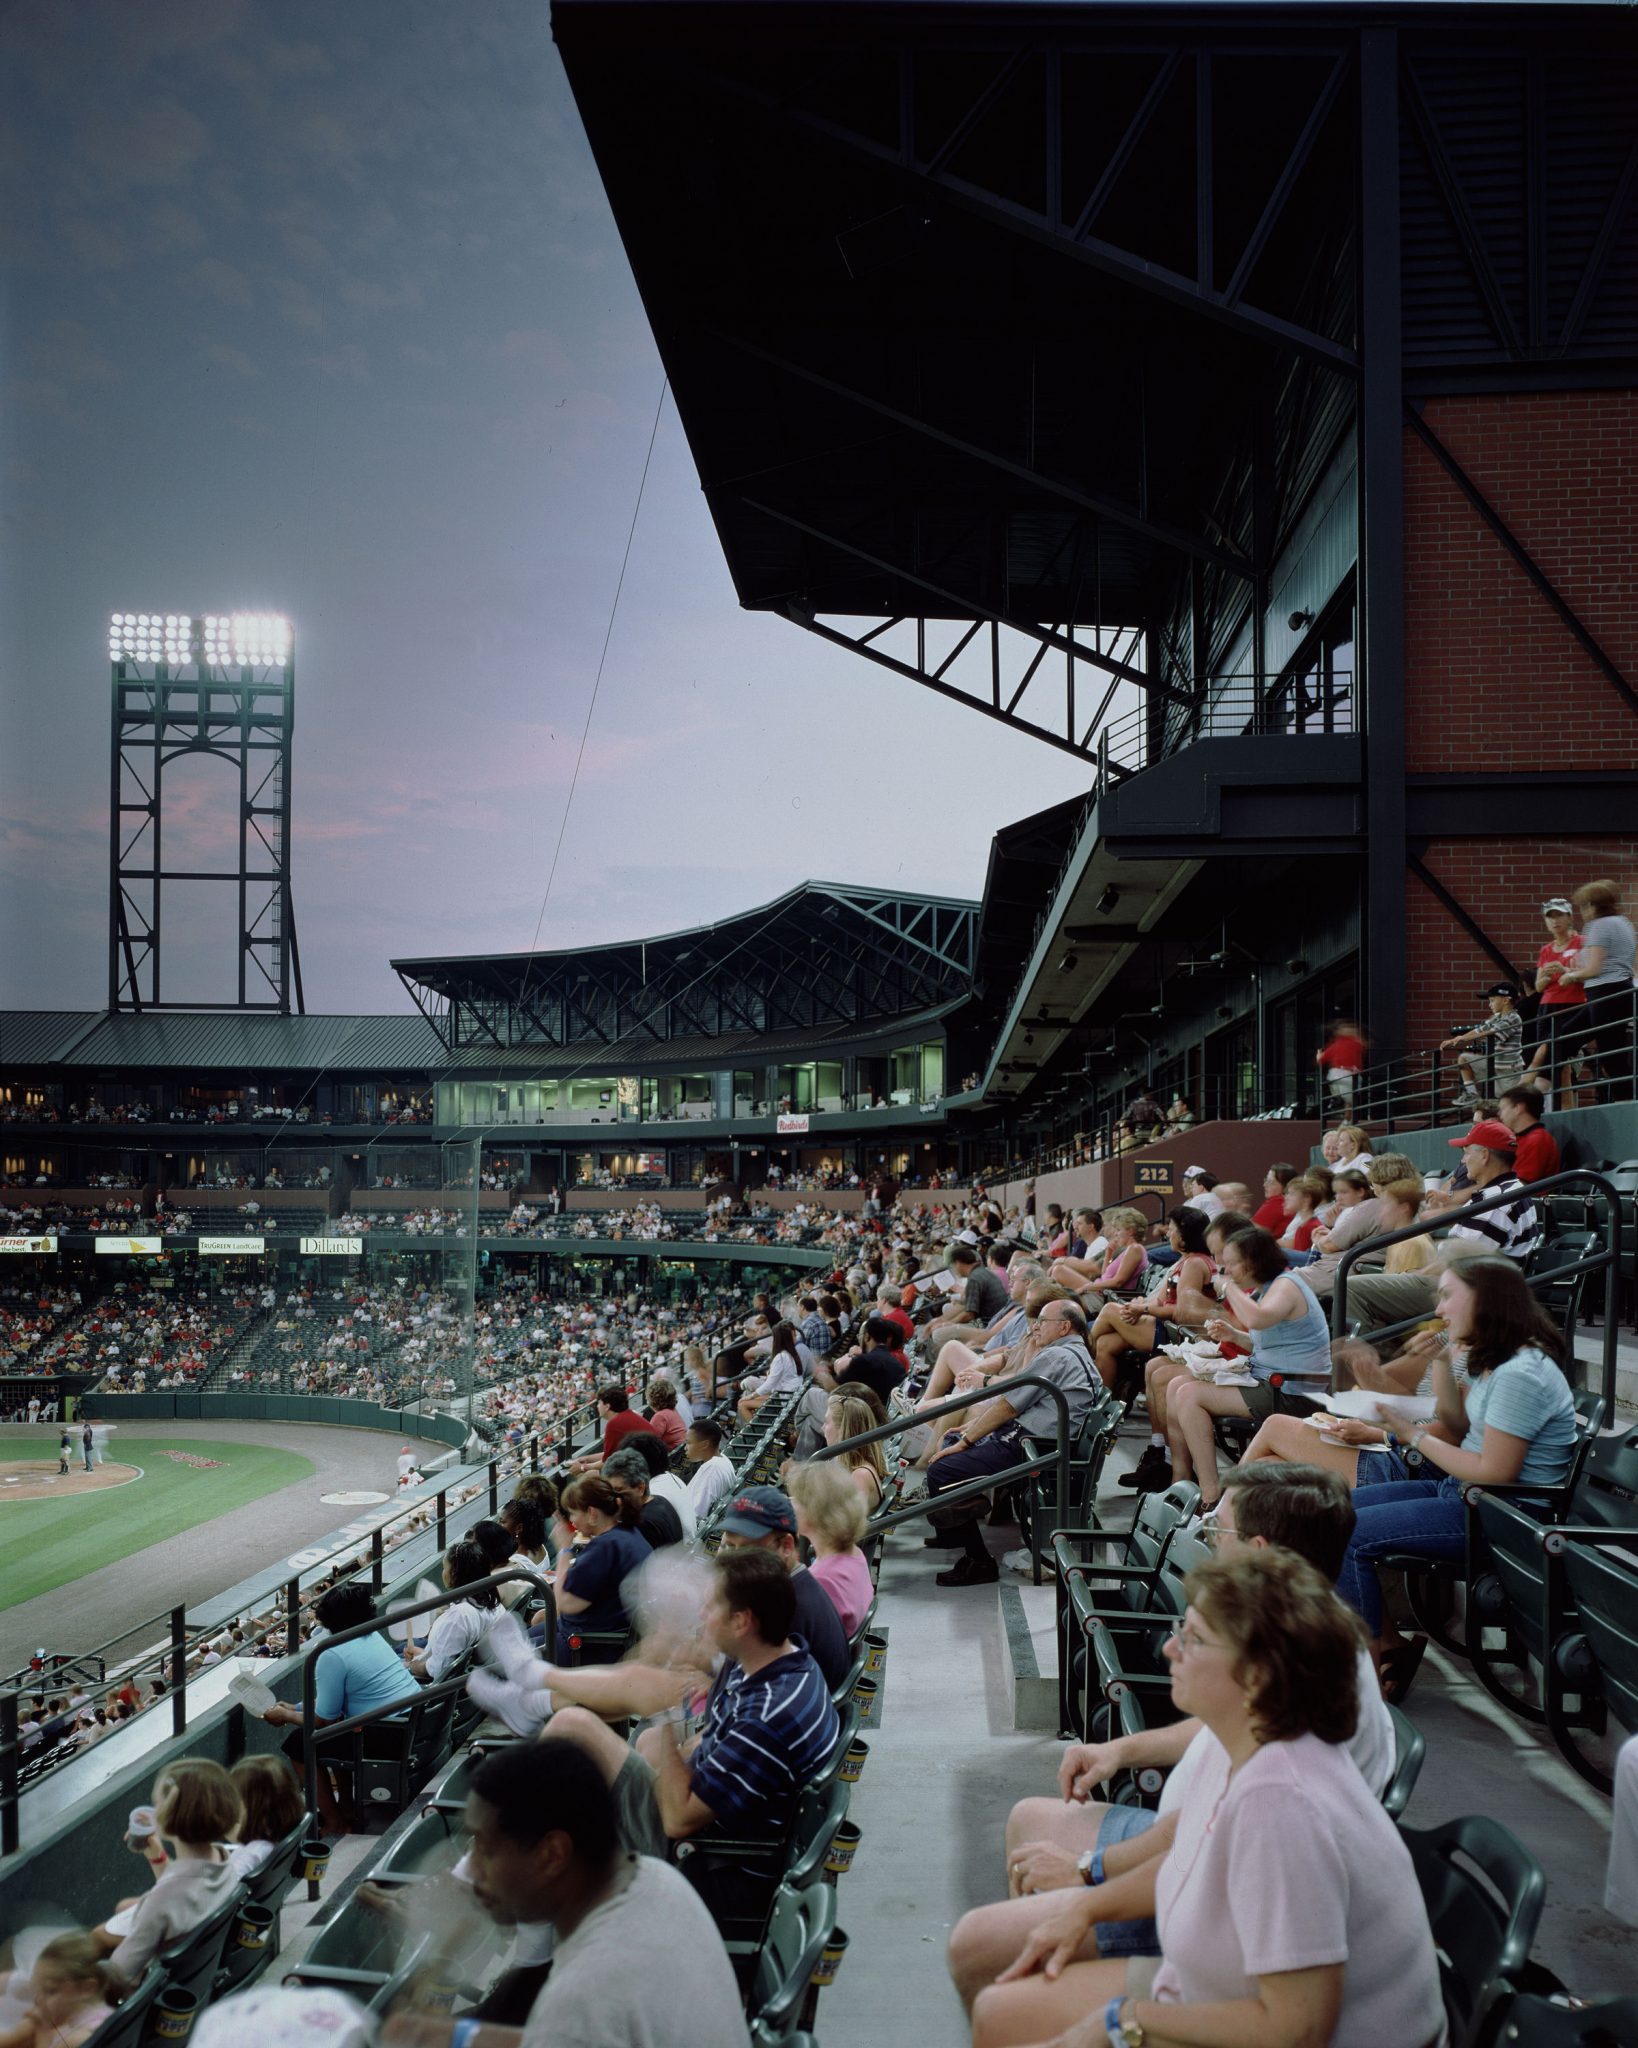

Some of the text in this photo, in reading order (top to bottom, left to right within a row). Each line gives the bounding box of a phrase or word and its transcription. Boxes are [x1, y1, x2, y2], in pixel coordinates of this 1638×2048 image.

[1140, 1167, 1169, 1181] 212
[304, 1238, 358, 1253] Dillard's
[1551, 1539, 1560, 1548] 4
[1115, 1688, 1122, 1696] 4
[1147, 1775, 1155, 1786] 5
